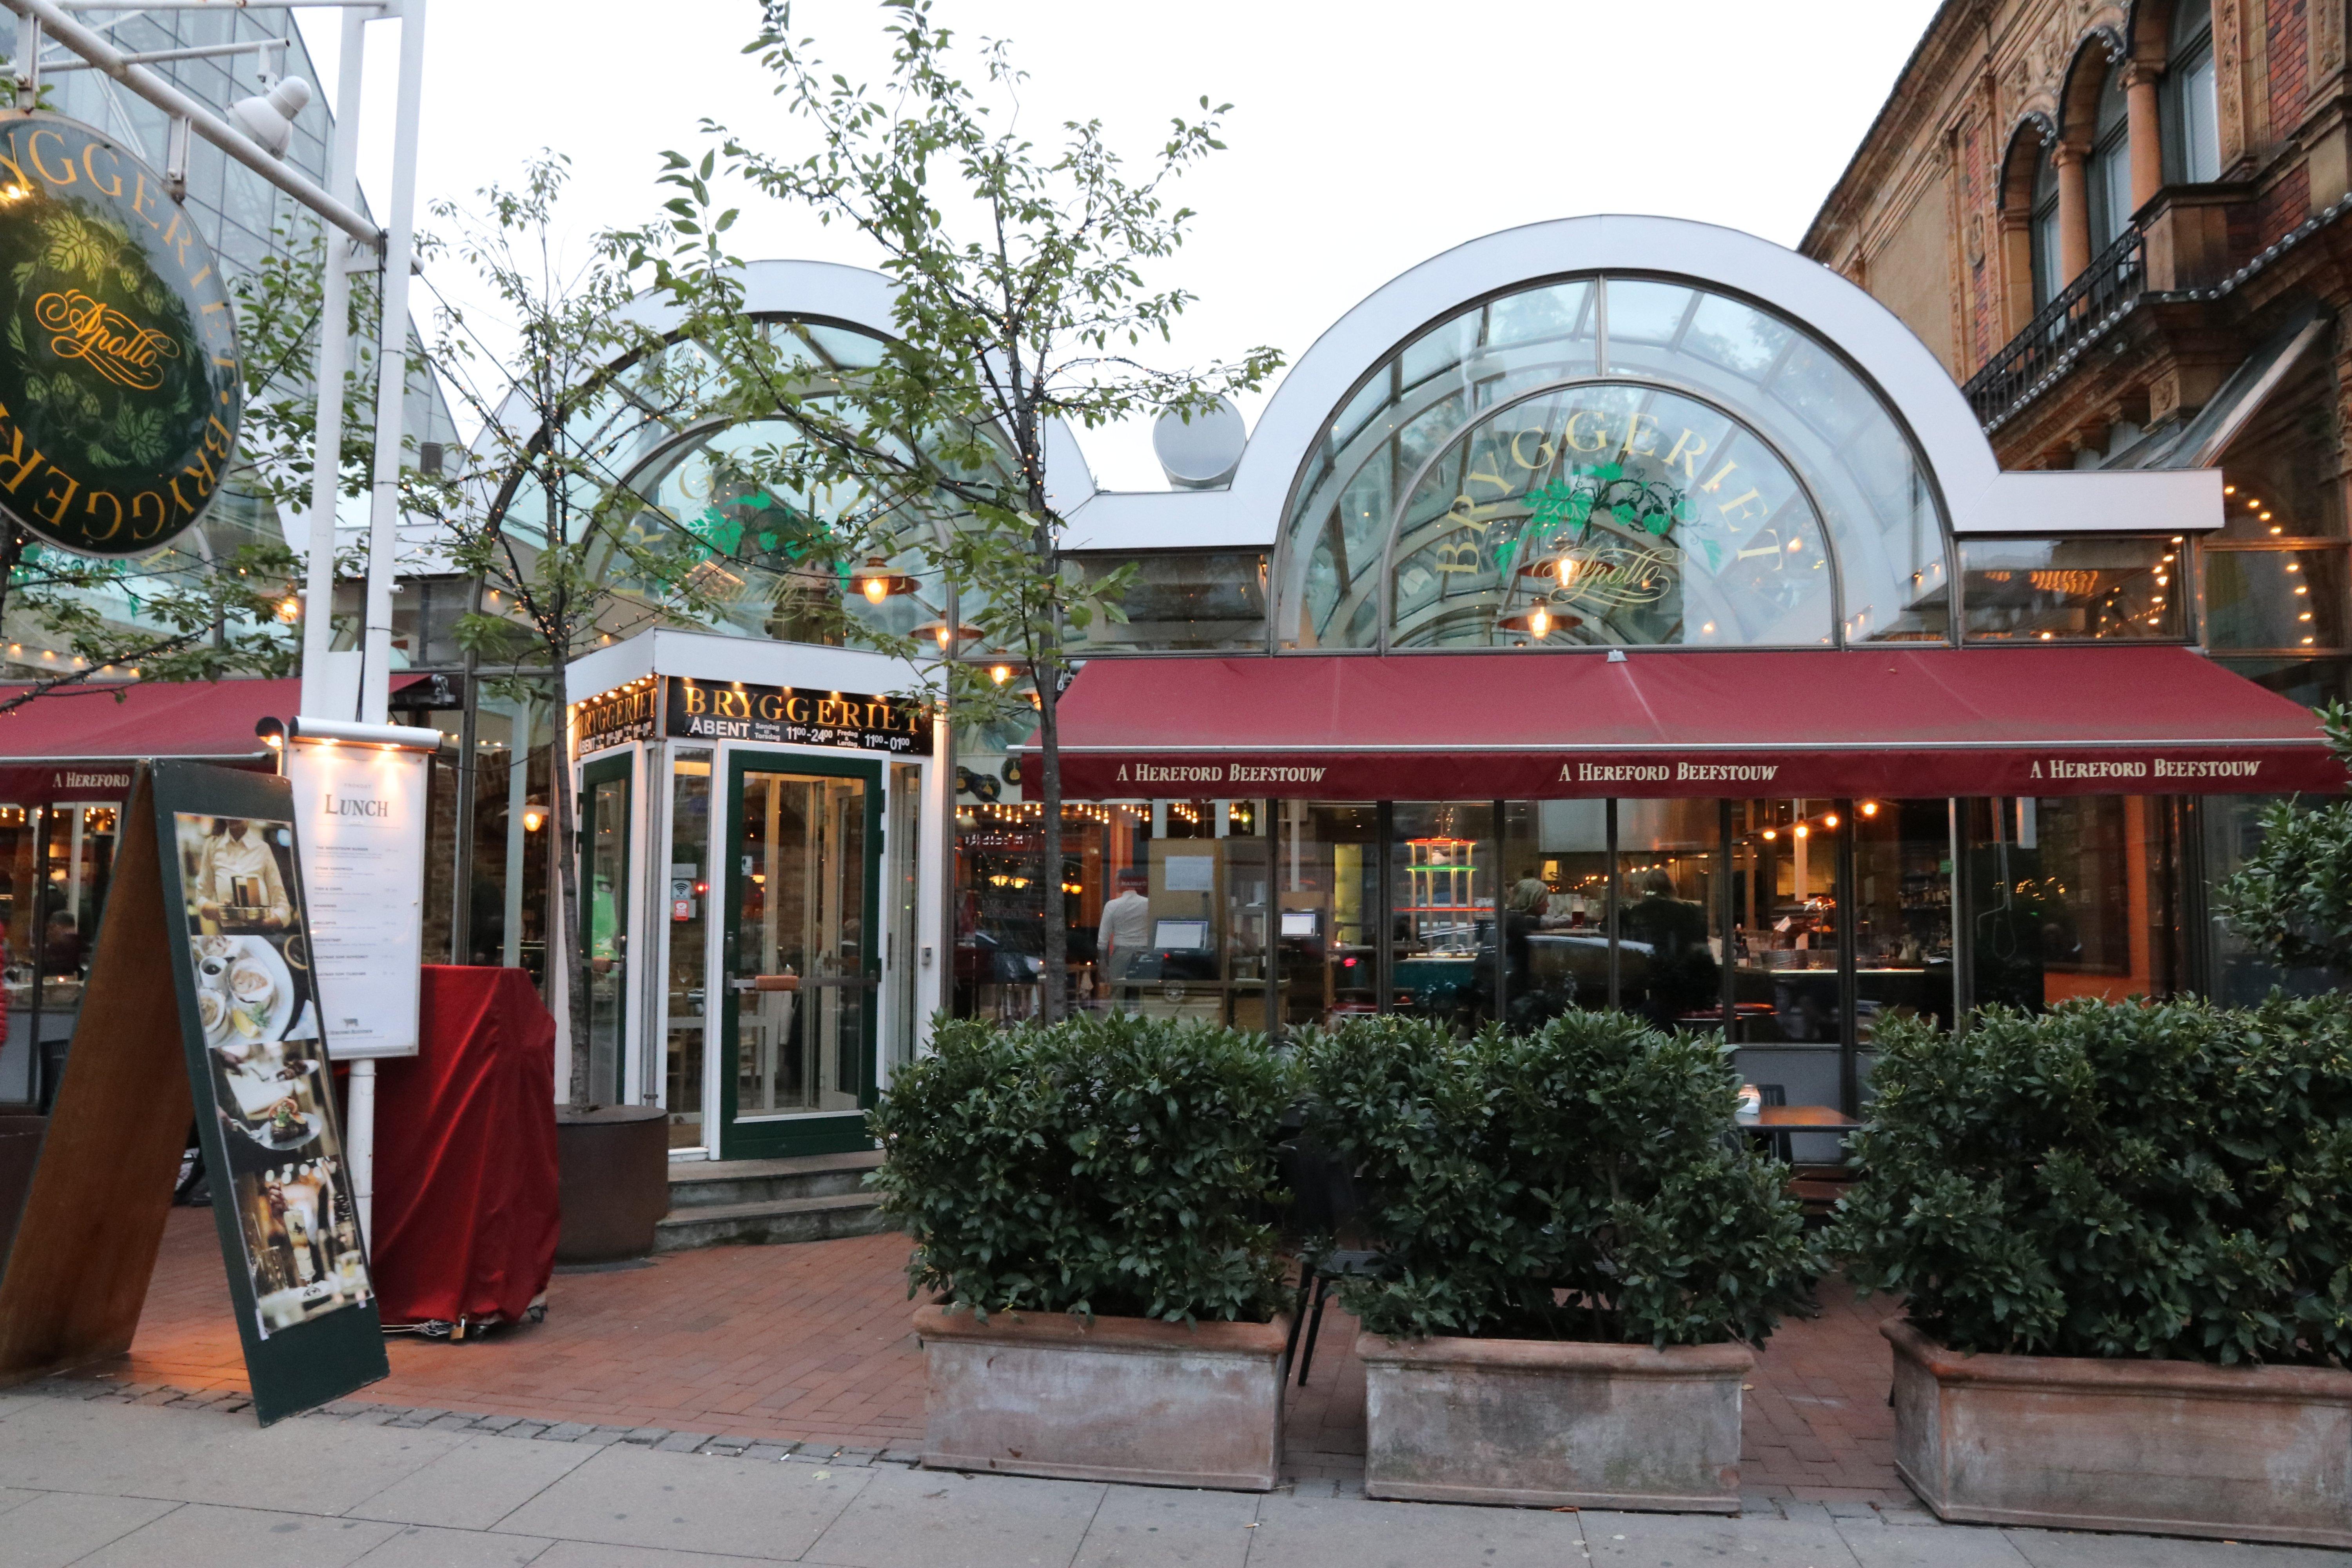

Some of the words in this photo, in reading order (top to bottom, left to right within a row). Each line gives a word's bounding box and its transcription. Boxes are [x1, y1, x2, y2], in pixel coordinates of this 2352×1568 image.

[0, 130, 236, 386] YGGERIET
[36, 289, 180, 390] Apollo
[0, 402, 232, 540] BRYGGER
[1436, 411, 1782, 575] BRYGGERIET
[1531, 547, 1688, 607] Apollo
[690, 716, 751, 737] ÅBENT
[755, 722, 780, 732] Søndag
[837, 729, 858, 739] Fredag
[754, 732, 780, 742] Torsdag
[837, 739, 858, 748] Lørdag
[1117, 764, 1129, 782] A
[1135, 763, 1223, 782] HEREFORD
[1229, 763, 1327, 782] BEEFSTOUW
[1559, 763, 1572, 782] A
[1579, 763, 1670, 781] HEREFORD
[1676, 762, 1779, 781] BEEFSTOUW
[2030, 760, 2043, 779] A
[2050, 760, 2147, 779] HEREFORD
[2154, 759, 2262, 777] BEEFSTOUW
[53, 773, 62, 788] A
[66, 771, 130, 788] HEREFORD
[325, 794, 388, 817] LUNCH
